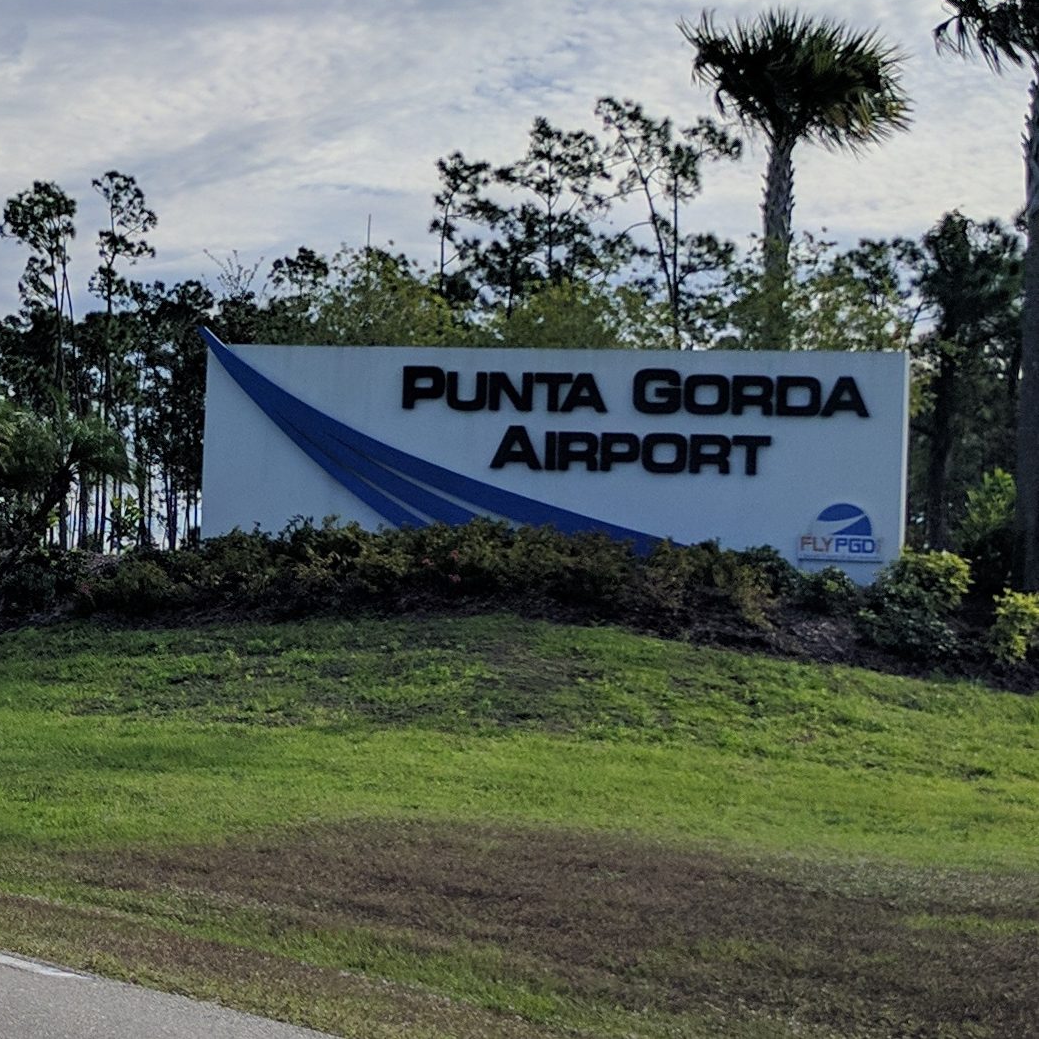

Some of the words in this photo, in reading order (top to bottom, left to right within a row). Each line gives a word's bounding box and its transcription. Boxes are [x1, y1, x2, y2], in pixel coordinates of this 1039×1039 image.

[401, 365, 607, 414] PUNTA
[632, 368, 870, 419] GORDA
[490, 425, 772, 476] AIRPORT
